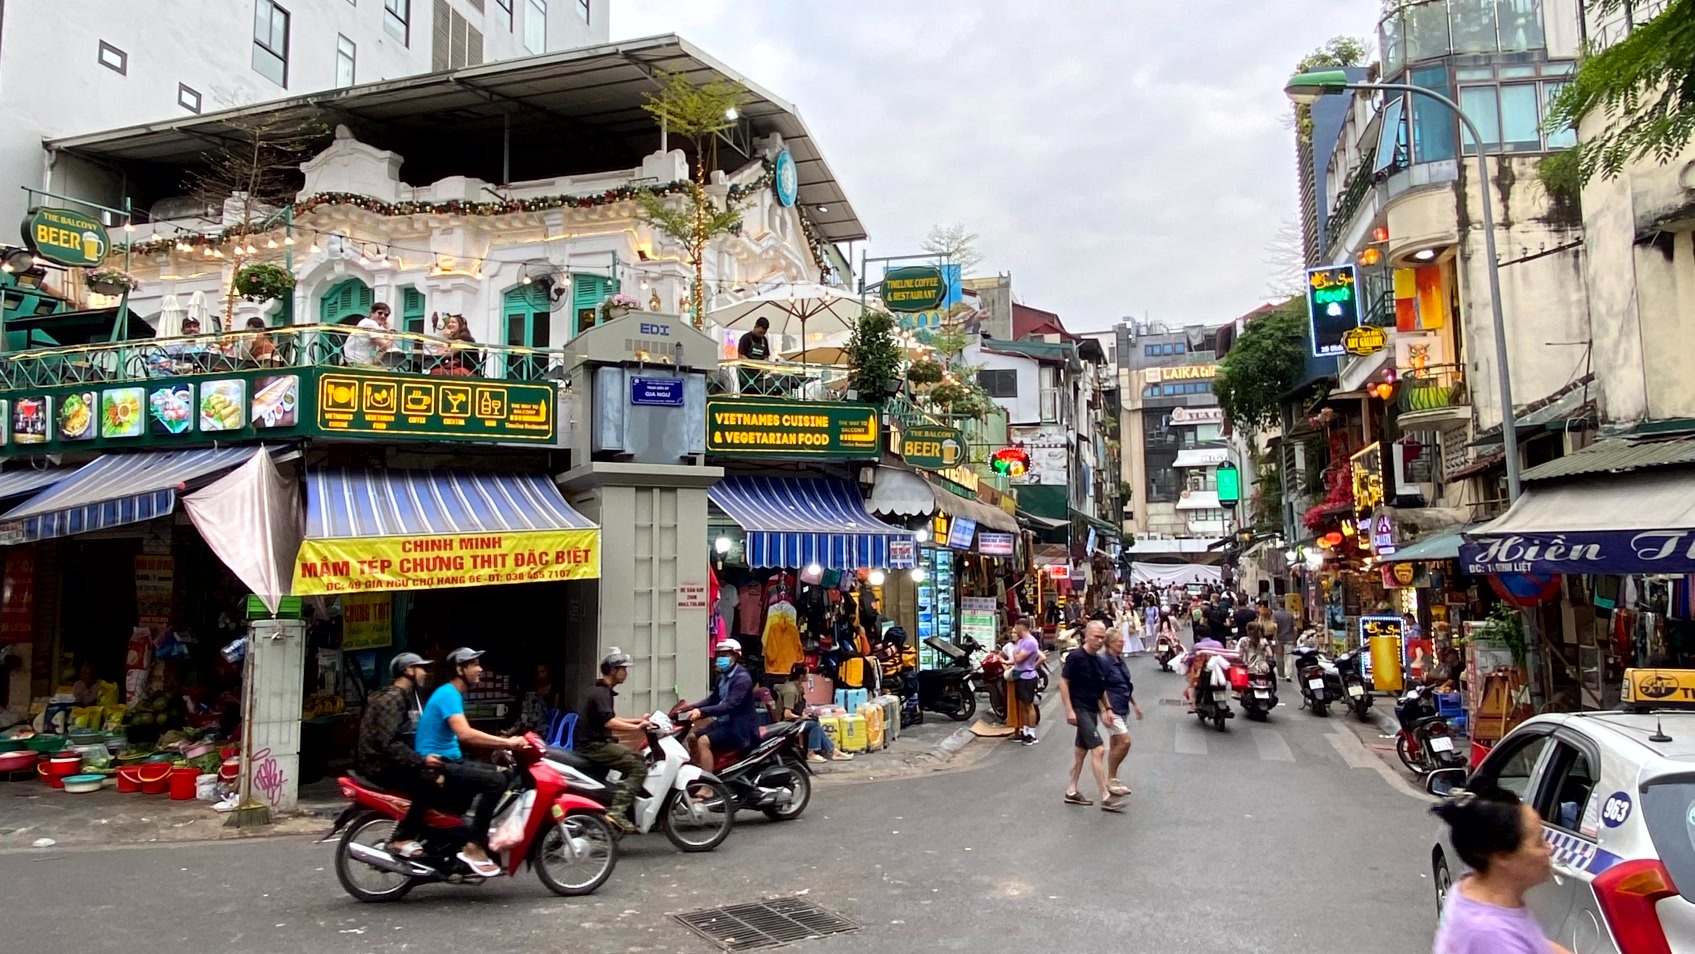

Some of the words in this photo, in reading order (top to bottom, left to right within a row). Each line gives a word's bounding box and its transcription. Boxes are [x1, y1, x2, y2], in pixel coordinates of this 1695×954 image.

[43, 212, 59, 223] THE
[60, 215, 97, 230] BALCONY
[37, 224, 81, 250] BEER
[887, 279, 914, 289] TIMELINE
[914, 277, 938, 288] COFFEE
[887, 292, 892, 301] &
[893, 290, 936, 300] RESTAURANT
[1316, 287, 1350, 304] Foot
[640, 322, 669, 336] EDI
[1163, 366, 1199, 380] LAIKA
[715, 412, 780, 426] VIETNAMES
[782, 414, 829, 428] CUISINE
[713, 431, 723, 444] &
[725, 431, 797, 445] VEGETARIAN
[798, 433, 830, 446] FOOD
[924, 430, 956, 438] BALCONY
[904, 440, 941, 457] BEER
[402, 539, 453, 553] CHINH
[460, 536, 502, 550] MINH
[1475, 534, 1607, 562] Hiền
[301, 555, 350, 578] MẮM
[356, 556, 392, 575] TÉP
[400, 554, 464, 574] CHƯNG
[470, 553, 508, 572] THỊT
[514, 549, 549, 570] ĐẶC
[555, 546, 591, 567] BIỆT
[1514, 561, 1532, 573] LIỆT
[350, 580, 361, 590] 49
[365, 579, 382, 589] GIA
[506, 572, 524, 580] 038
[548, 569, 571, 578] 7107
[1603, 797, 1629, 822] 963
